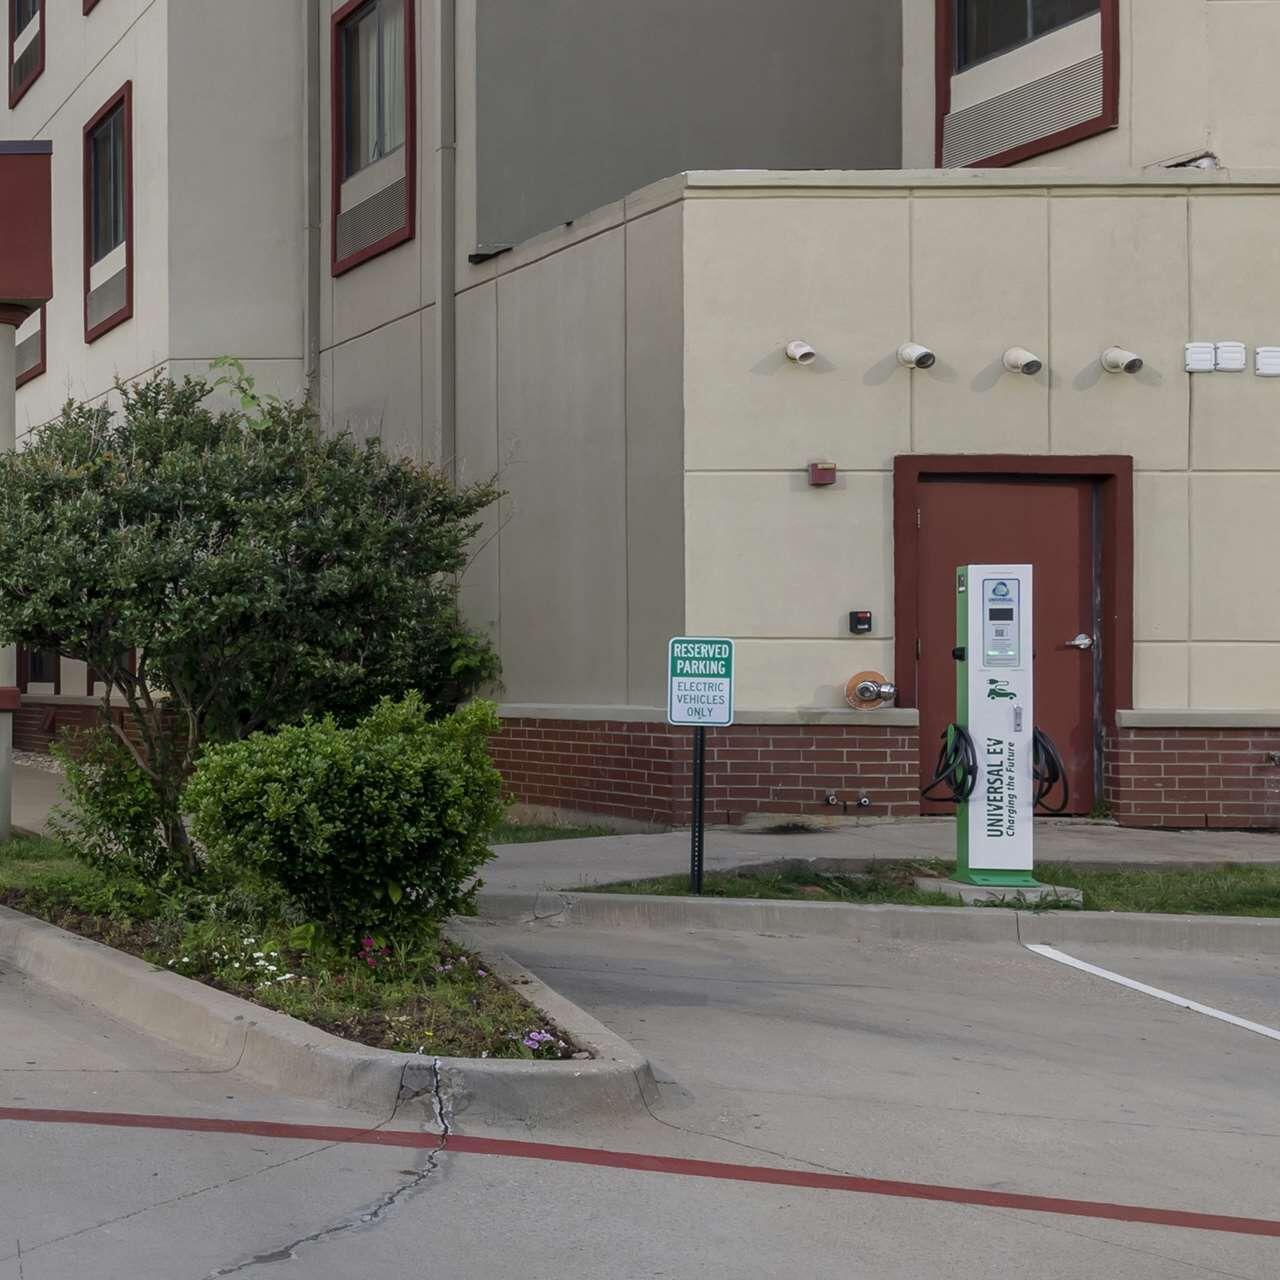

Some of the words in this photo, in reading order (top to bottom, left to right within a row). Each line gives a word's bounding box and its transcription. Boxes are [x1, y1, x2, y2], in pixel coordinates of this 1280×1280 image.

[674, 643, 729, 658] RESERVED
[676, 660, 726, 674] PARKING
[677, 681, 724, 692] ELECTRIC
[677, 695, 725, 705] VEHICLES
[687, 707, 713, 717] ONLY
[987, 737, 1004, 755] EV
[1006, 742, 1015, 773] Future
[1006, 775, 1015, 791] the
[987, 761, 1004, 838] UNIVERSAL
[1007, 793, 1018, 837] Charging
